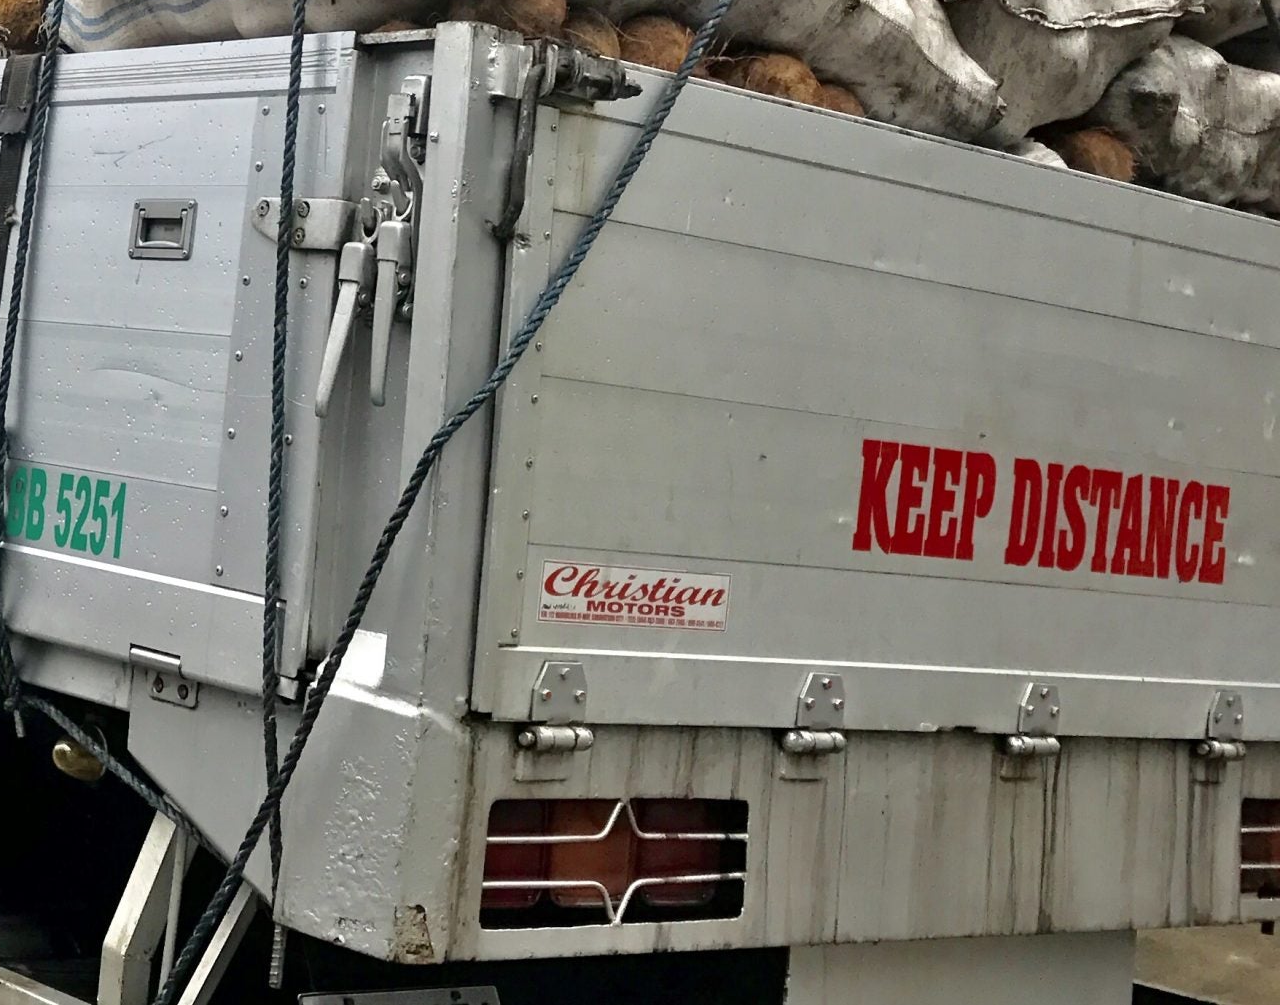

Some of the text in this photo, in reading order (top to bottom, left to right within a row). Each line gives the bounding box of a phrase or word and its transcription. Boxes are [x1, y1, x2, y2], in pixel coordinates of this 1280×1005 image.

[53, 473, 127, 559] 5251
[852, 439, 1231, 585] KEEP DISTANCE
[543, 565, 726, 607] Christian
[586, 600, 686, 618] MOTORS
